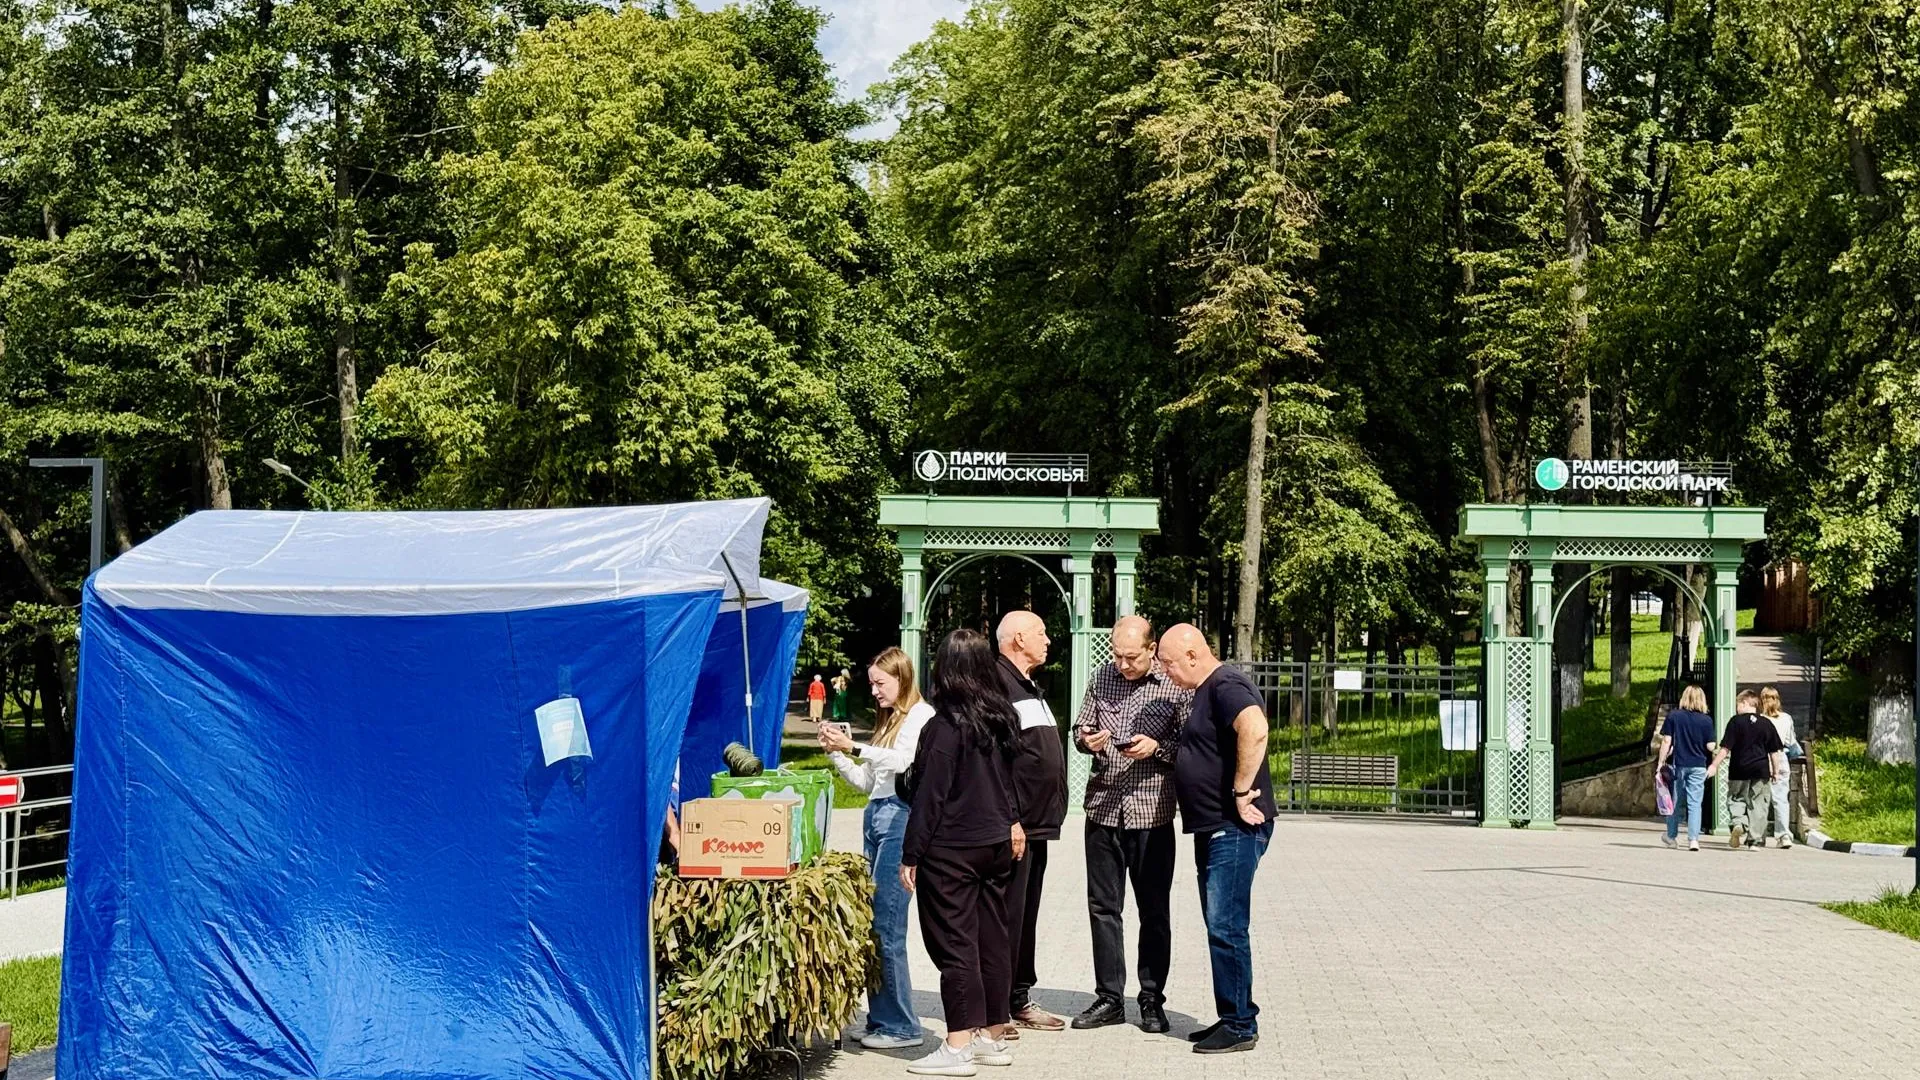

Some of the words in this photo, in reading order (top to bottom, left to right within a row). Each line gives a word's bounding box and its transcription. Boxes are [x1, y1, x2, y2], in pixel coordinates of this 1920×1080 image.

[950, 452, 1007, 465] ПАРКИ
[950, 467, 1084, 481] ПОДМОСКОВЬЯ
[1572, 460, 1679, 474] РАМЕНСКИЙ
[1572, 475, 1678, 491] ГОРОДСКОЙ
[1682, 476, 1728, 491] ПАРК
[763, 822, 781, 835] 09
